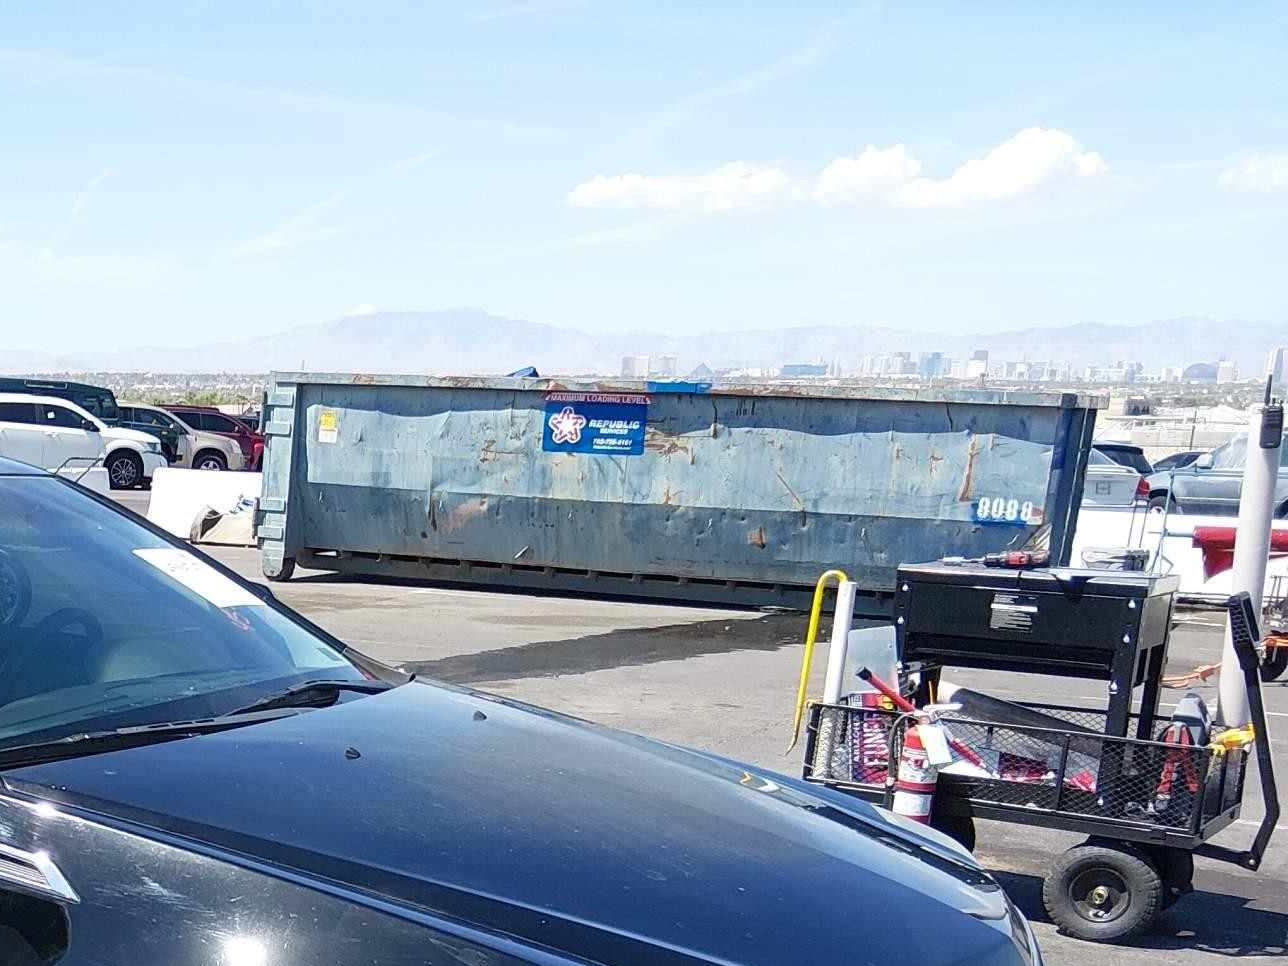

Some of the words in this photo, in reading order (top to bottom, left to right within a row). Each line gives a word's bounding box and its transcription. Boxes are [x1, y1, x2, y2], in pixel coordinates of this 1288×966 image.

[551, 392, 585, 402] MAXIMUM
[586, 394, 620, 403] LOADING
[588, 419, 641, 430] REPUBLIC
